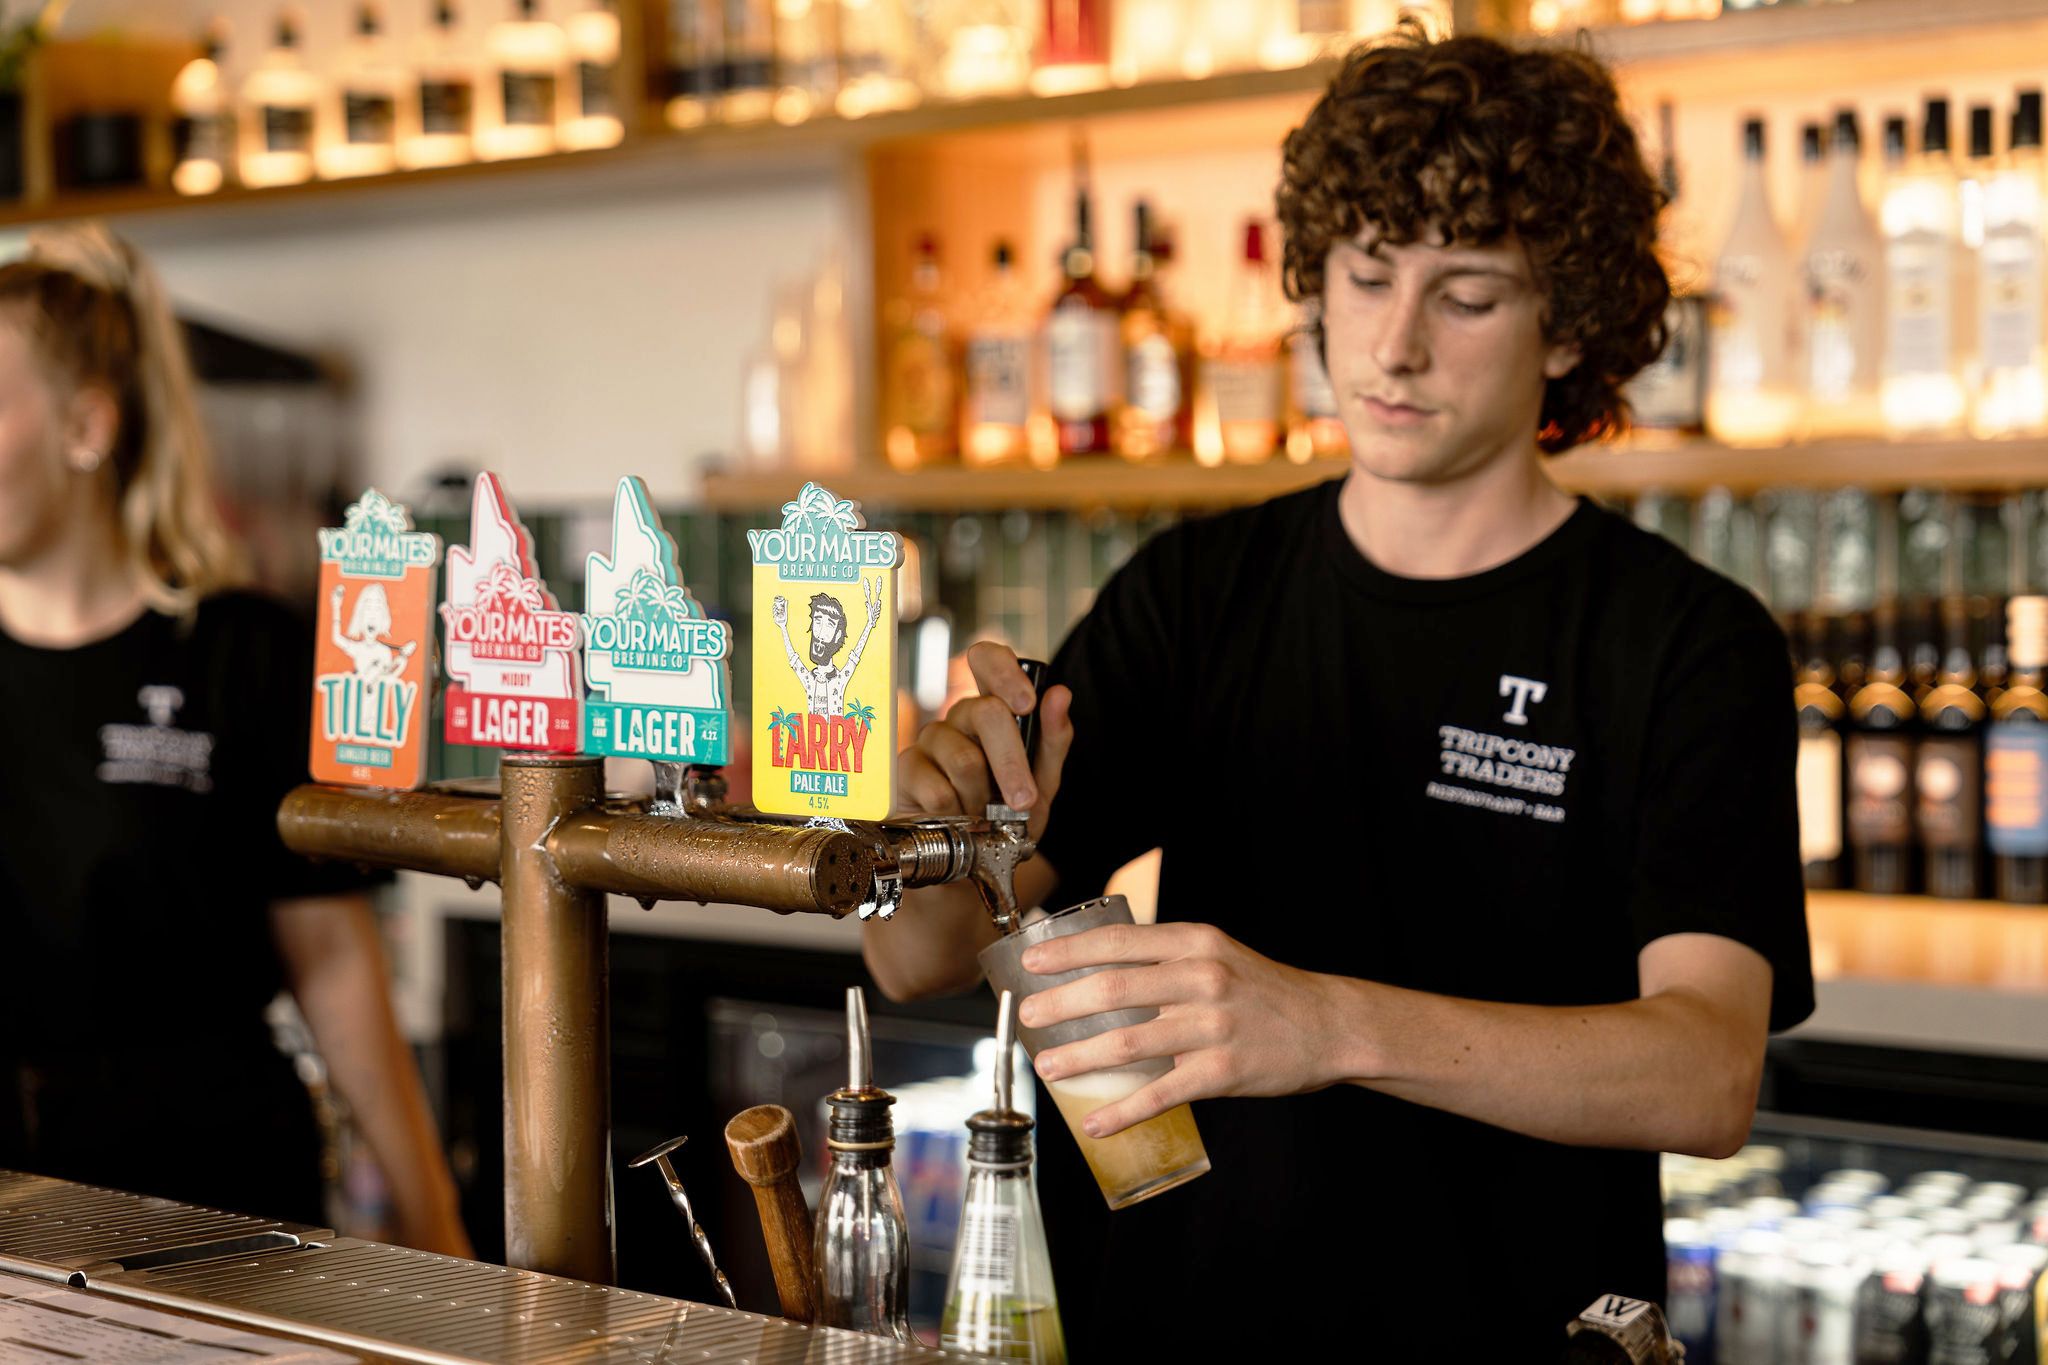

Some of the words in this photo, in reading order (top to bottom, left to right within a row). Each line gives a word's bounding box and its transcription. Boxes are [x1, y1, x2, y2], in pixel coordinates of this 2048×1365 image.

[783, 564, 837, 578] BREWING
[473, 642, 524, 659] BREWING
[613, 652, 667, 668] BREWING
[501, 673, 532, 687] MIDDY
[321, 677, 414, 742] TILLY
[1499, 674, 1548, 726] T
[472, 697, 549, 746] LAGER
[614, 708, 696, 757] LAGER
[771, 711, 873, 774] LARRY
[1438, 725, 1576, 773] TRIPCONY
[793, 773, 821, 792] PALE
[824, 774, 845, 795] ALE
[1440, 749, 1567, 797] TRADERS
[808, 795, 829, 810] 4.5%
[1603, 1295, 1645, 1317] W
